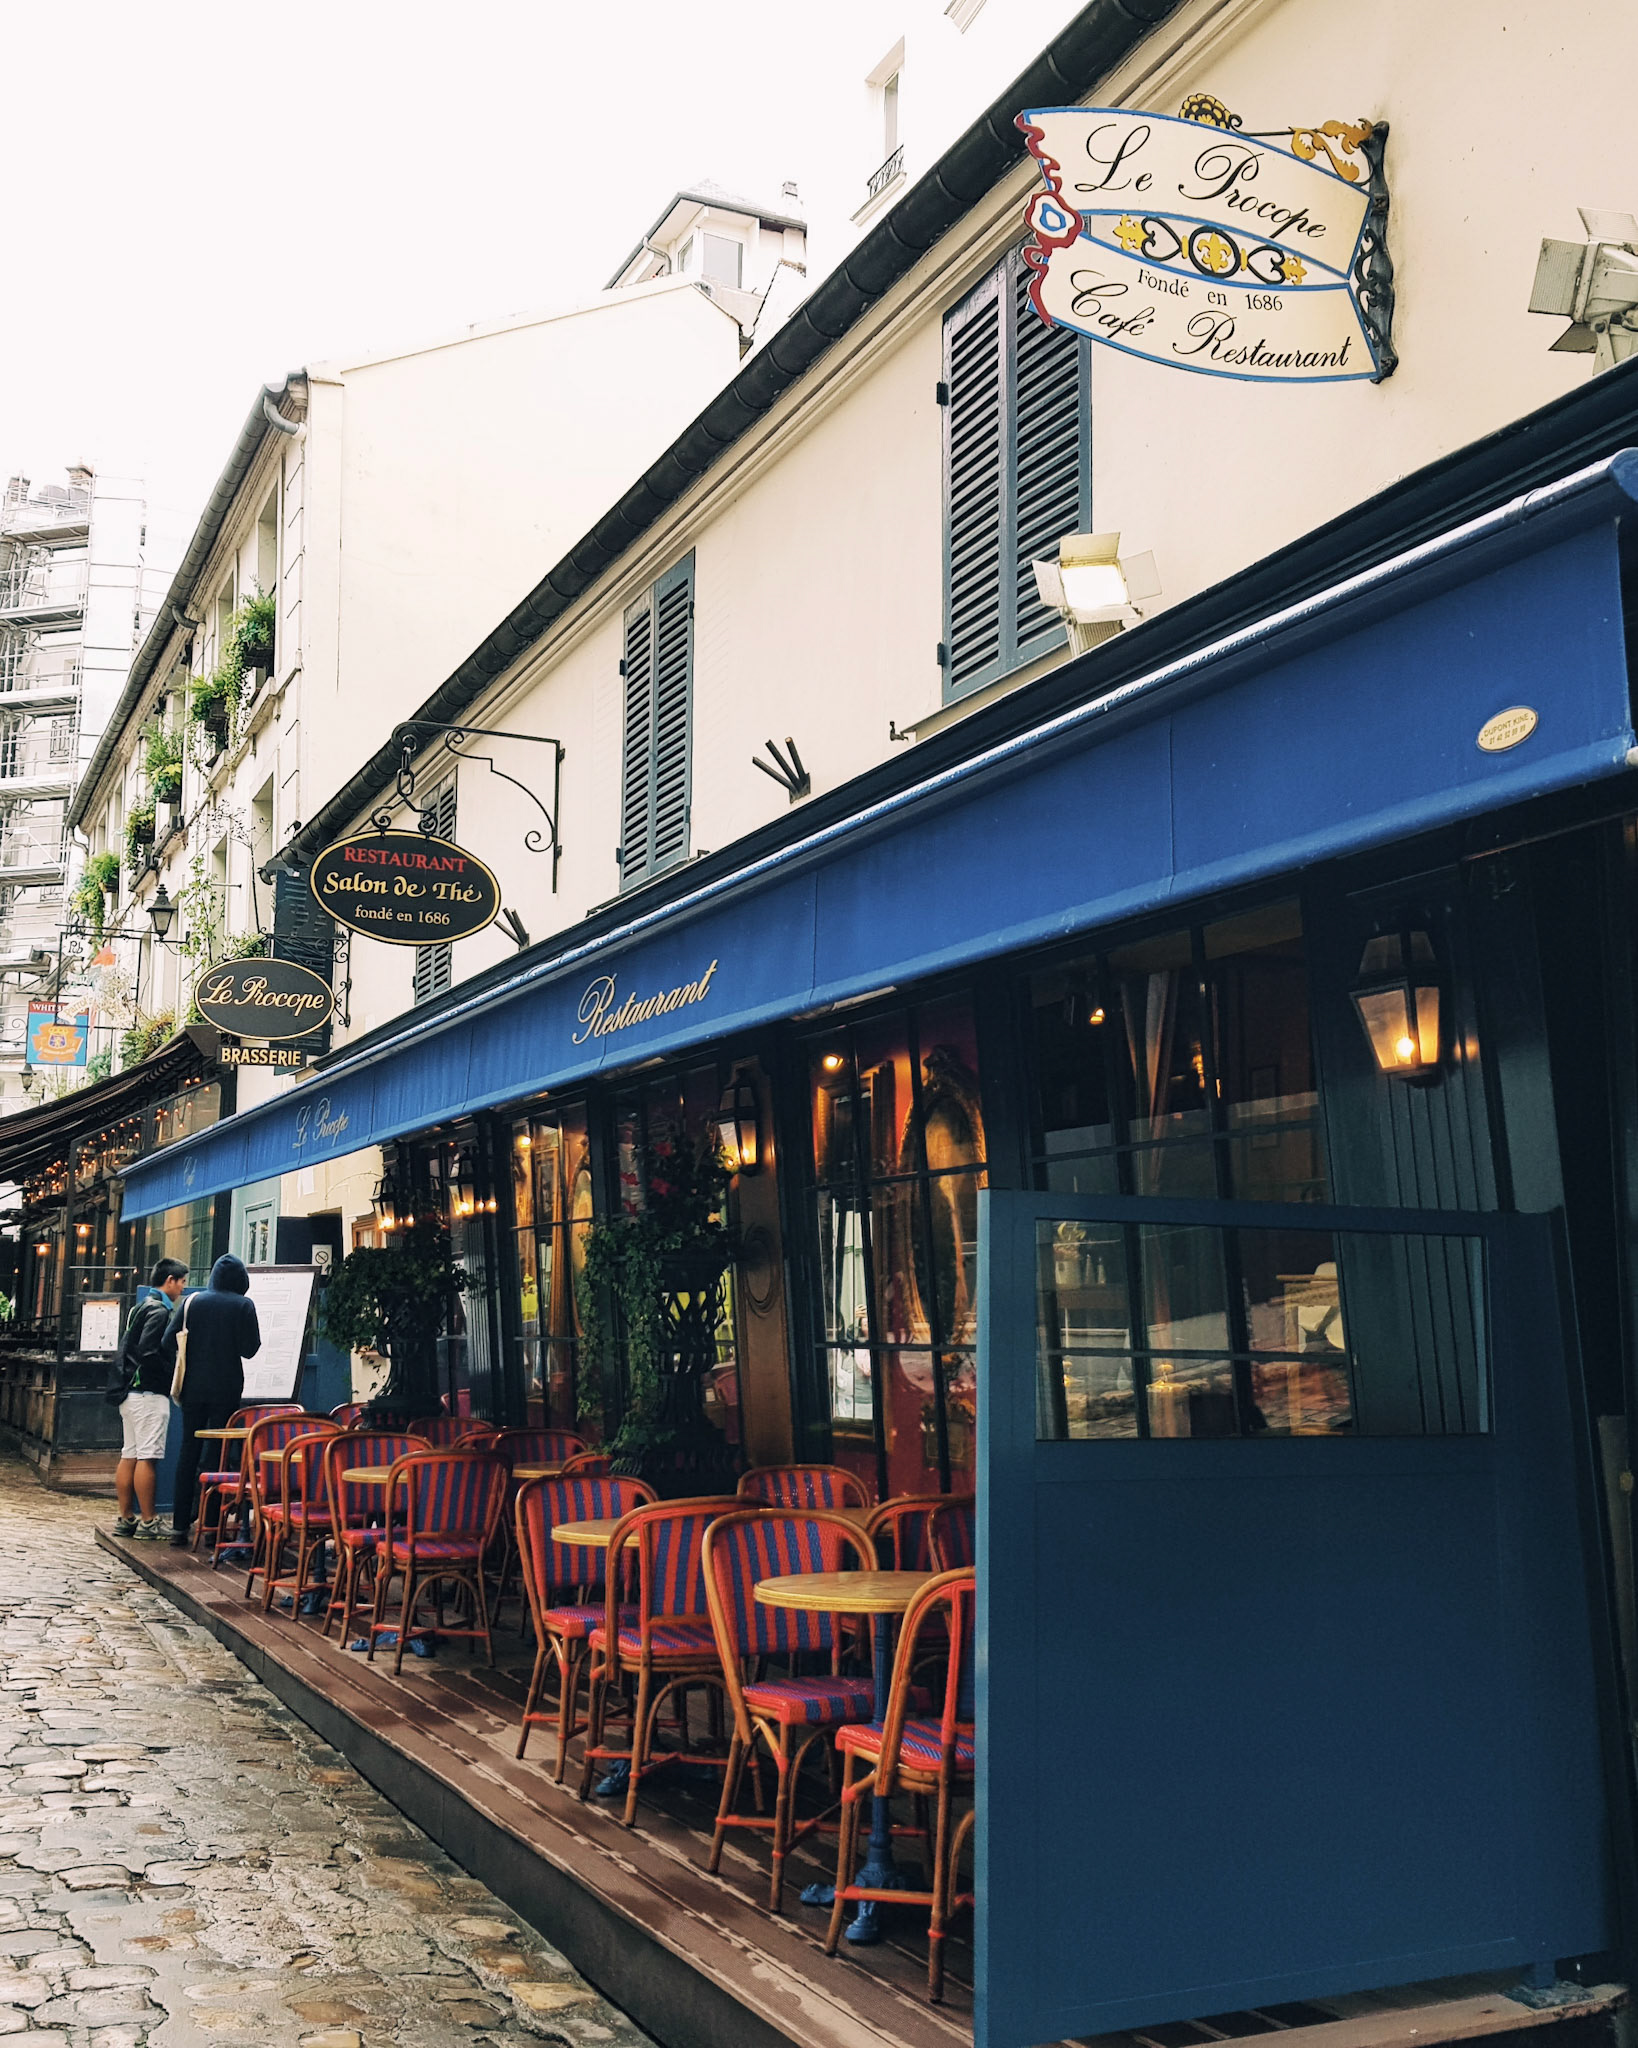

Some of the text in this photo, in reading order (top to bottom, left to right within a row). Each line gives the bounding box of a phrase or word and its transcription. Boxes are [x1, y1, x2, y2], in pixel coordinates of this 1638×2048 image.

[1074, 123, 1328, 240] Le Procope
[1137, 268, 1283, 312] Fondé en 1686
[1070, 269, 1352, 368] Café Restaurant
[1483, 720, 1510, 737] DUPONT
[344, 847, 468, 873] RESTAURANT
[323, 872, 483, 903] Salon de Thé
[354, 904, 451, 925] fondé en 1686
[200, 975, 324, 1016] Le Procope
[572, 959, 718, 1045] Restaurant
[221, 1047, 302, 1066] BRASSERIE
[292, 1105, 311, 1148] Le
